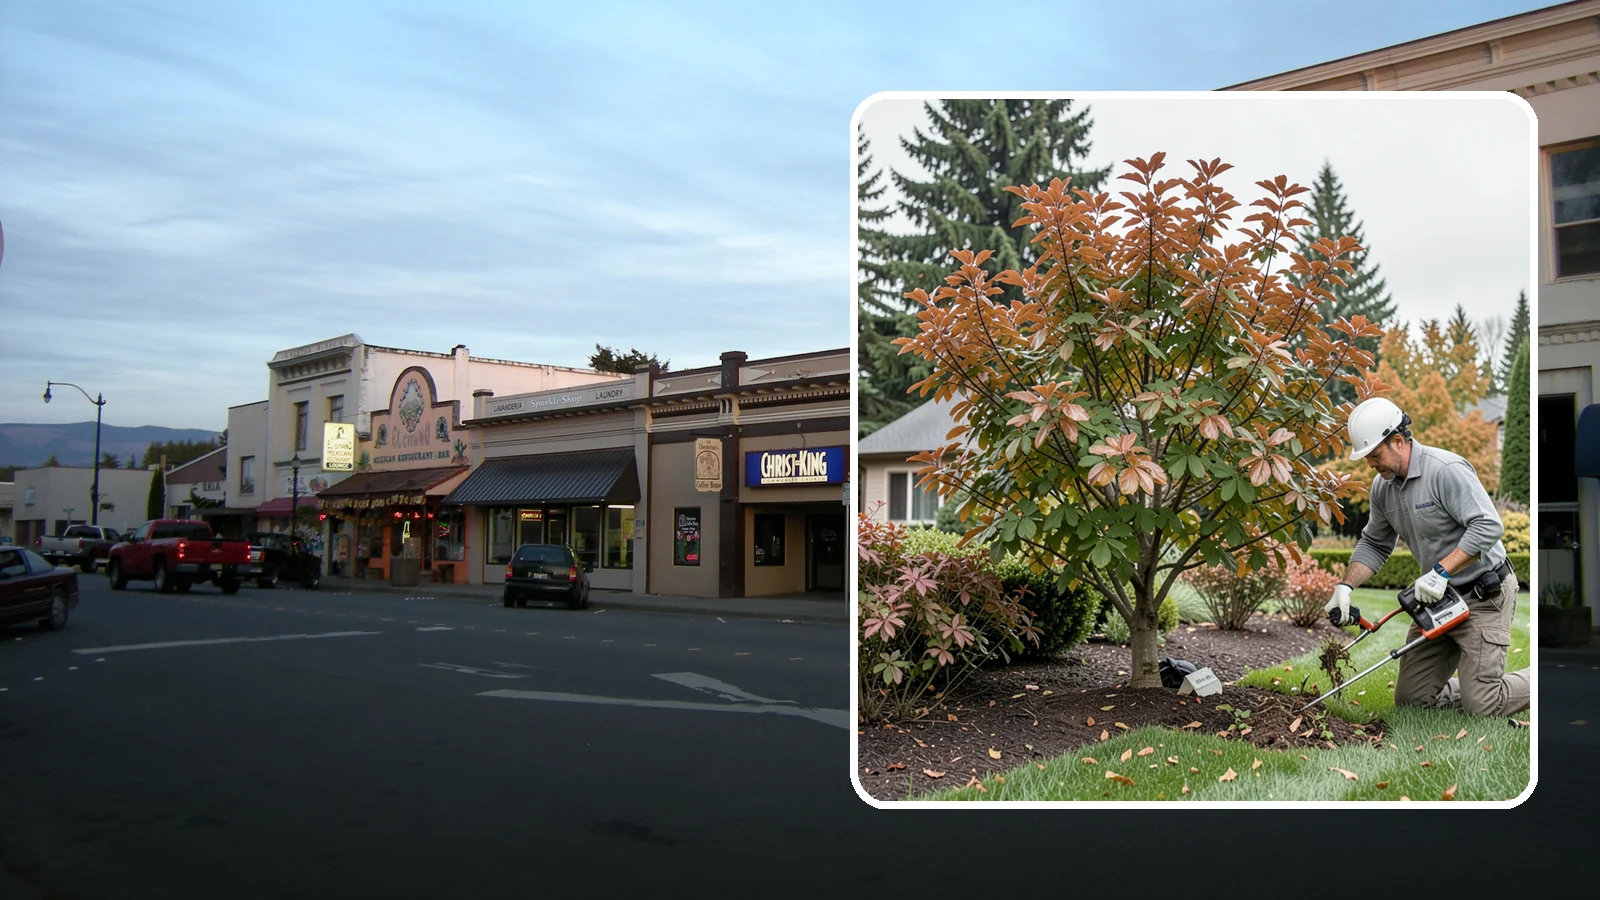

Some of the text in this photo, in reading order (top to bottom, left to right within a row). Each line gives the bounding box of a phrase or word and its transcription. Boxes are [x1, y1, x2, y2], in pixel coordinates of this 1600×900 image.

[596, 389, 623, 400] LAUNDRY
[494, 394, 583, 412] LAVANDERIA Sparkle Shop
[374, 454, 396, 464] MEXICAN
[397, 452, 434, 462] RESTAURANT
[438, 450, 450, 458] BAR
